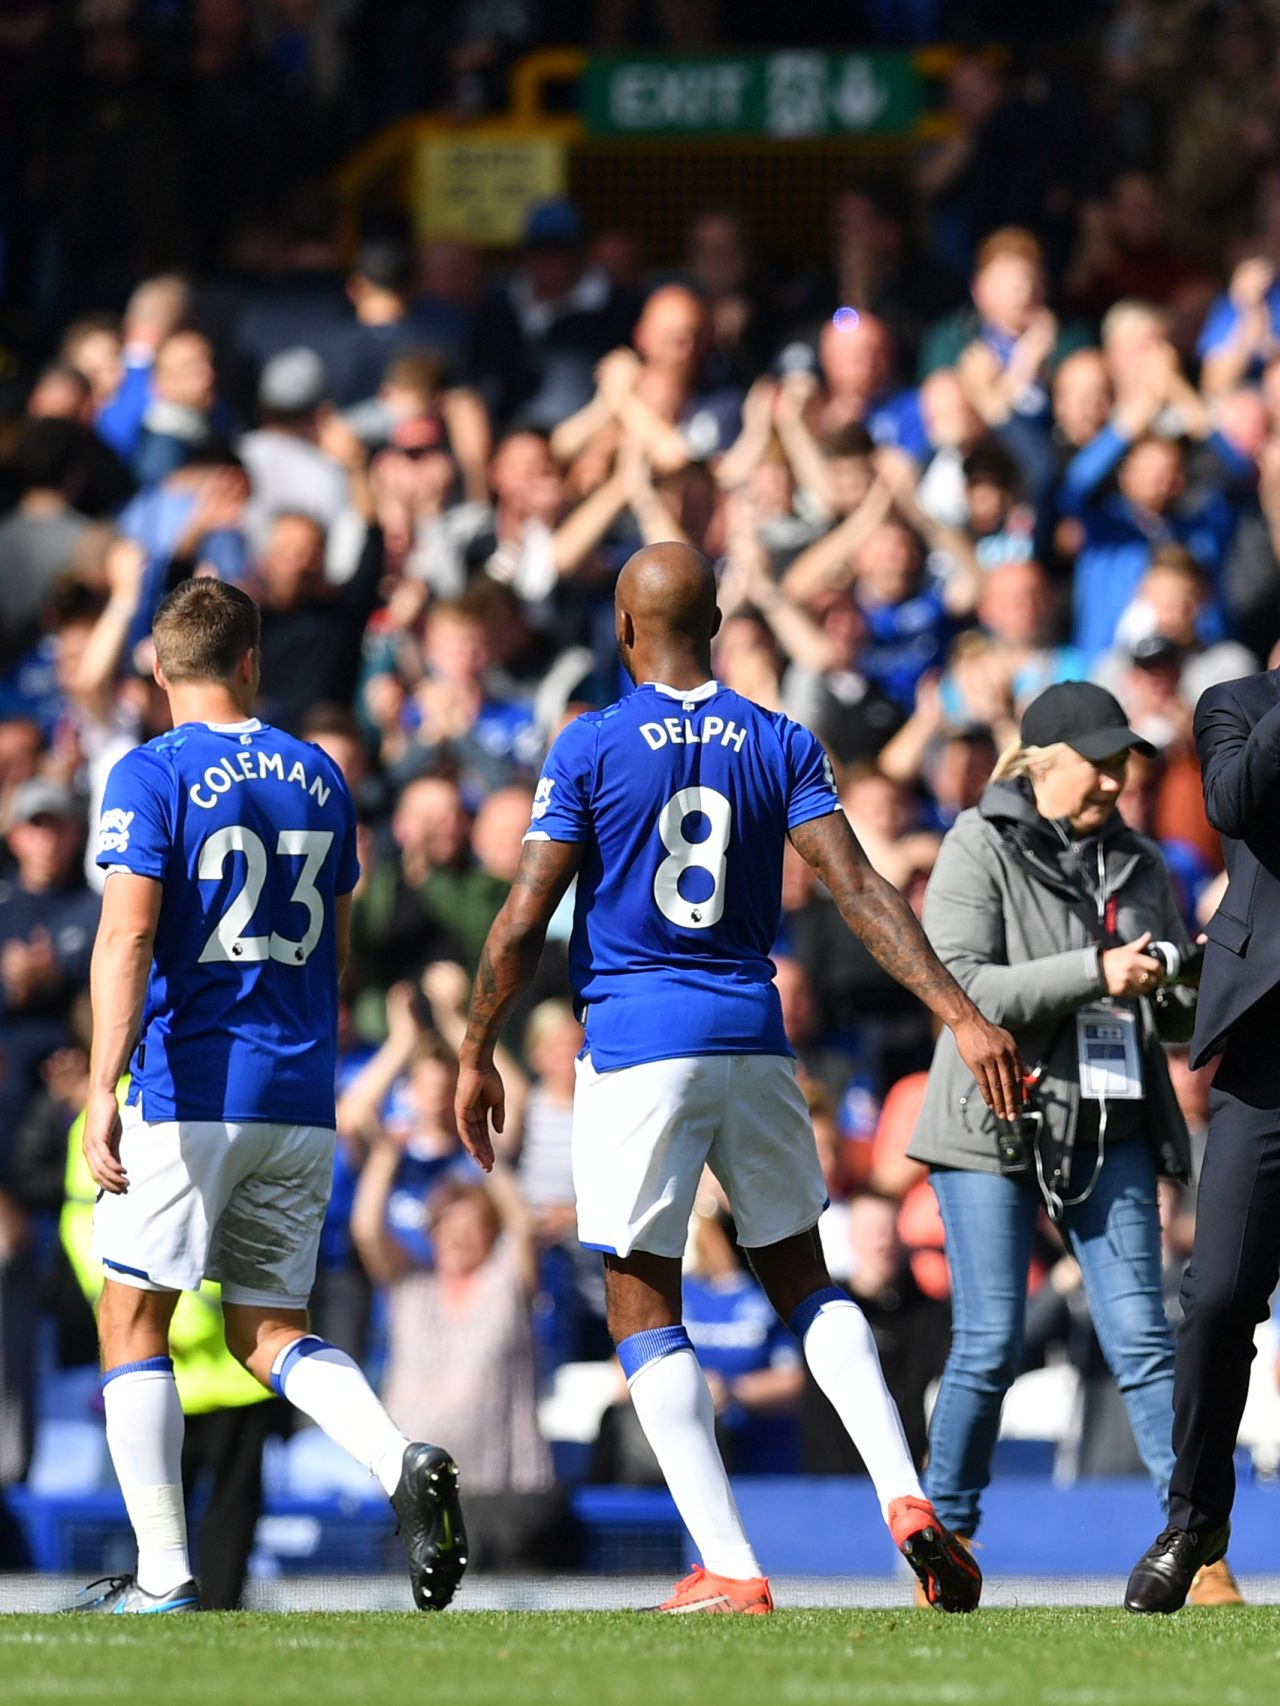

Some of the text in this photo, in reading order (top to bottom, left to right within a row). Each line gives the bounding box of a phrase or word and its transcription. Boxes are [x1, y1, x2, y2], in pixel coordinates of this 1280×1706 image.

[609, 62, 748, 128] EXIT
[638, 716, 747, 752] DELPH
[190, 751, 331, 809] COLEMAN
[654, 786, 732, 929] 8
[197, 825, 334, 966] 23
